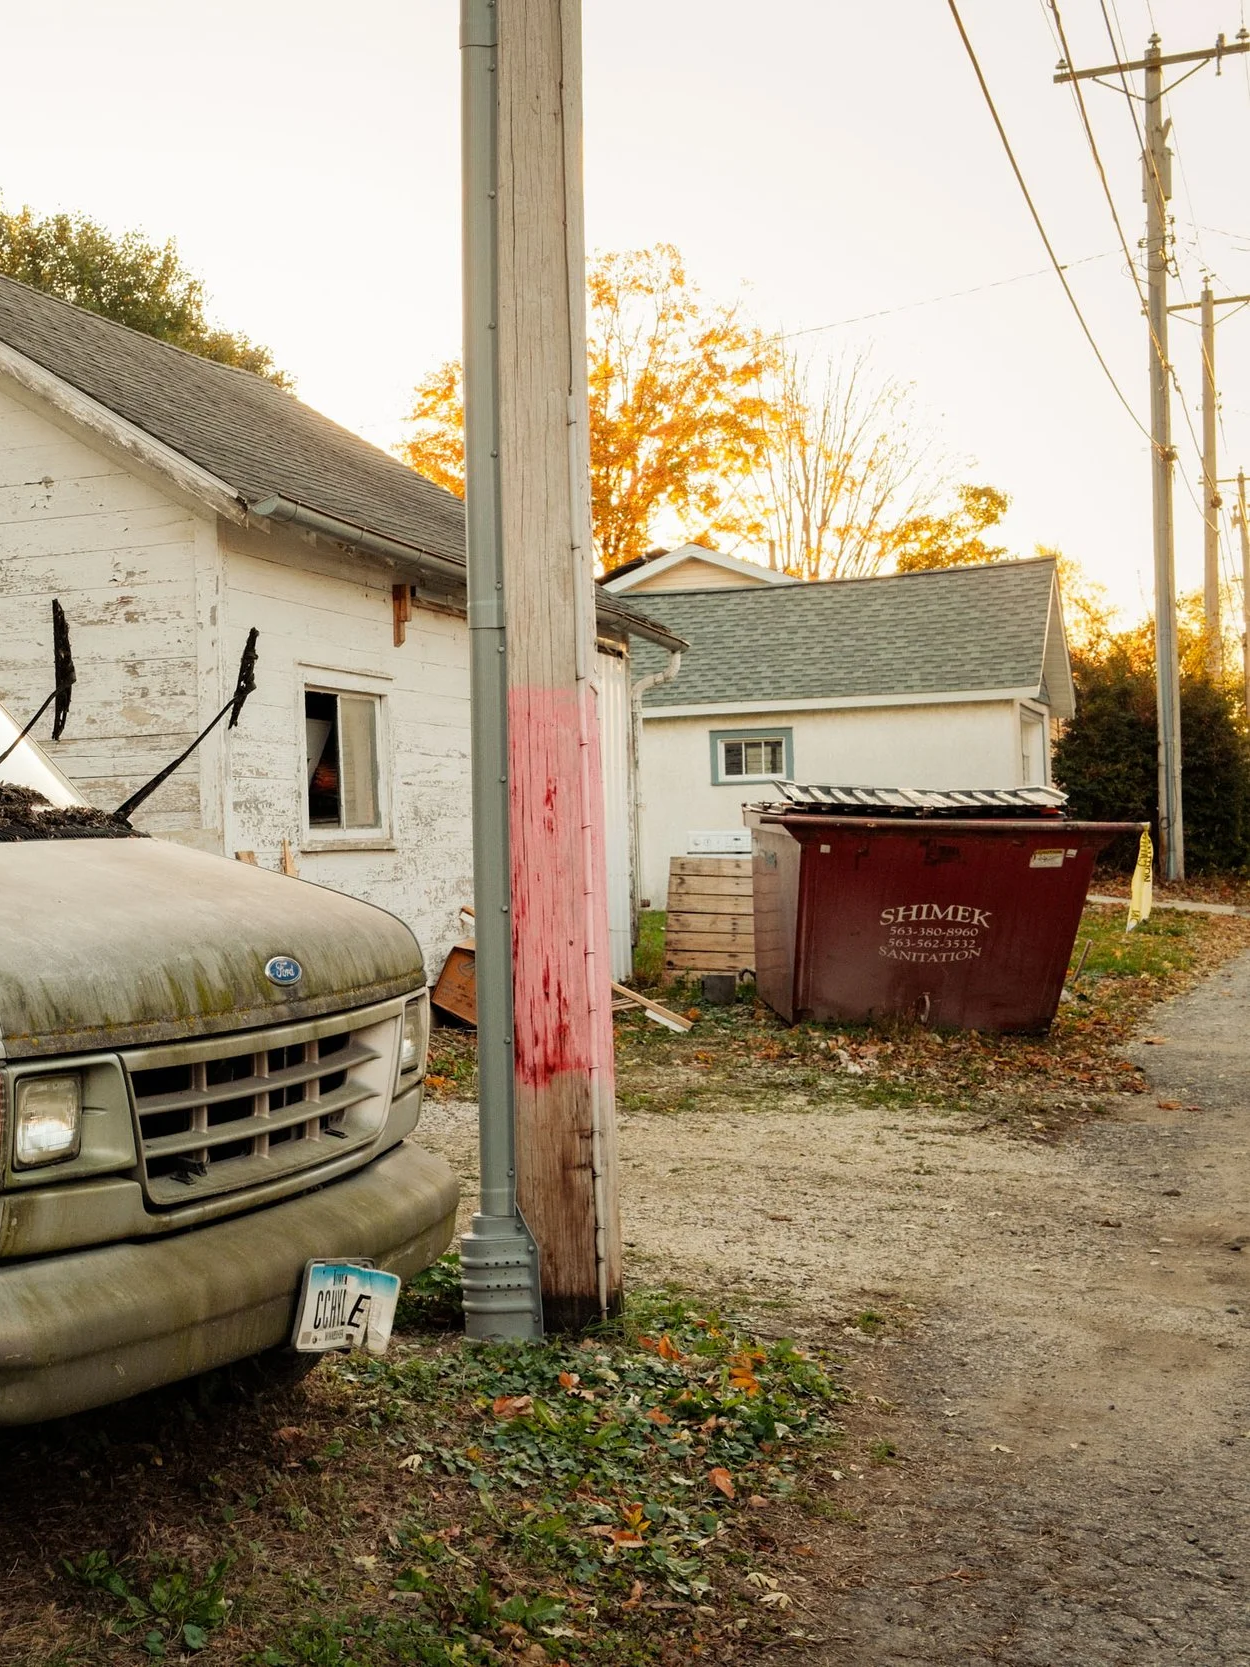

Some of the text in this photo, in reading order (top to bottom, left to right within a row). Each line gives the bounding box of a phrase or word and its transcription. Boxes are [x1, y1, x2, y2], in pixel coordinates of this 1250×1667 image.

[879, 903, 992, 929] SHIMEK
[889, 926, 979, 937] 563-380-8960
[887, 938, 976, 949] 563-562-3532
[878, 946, 982, 963] SANITATION
